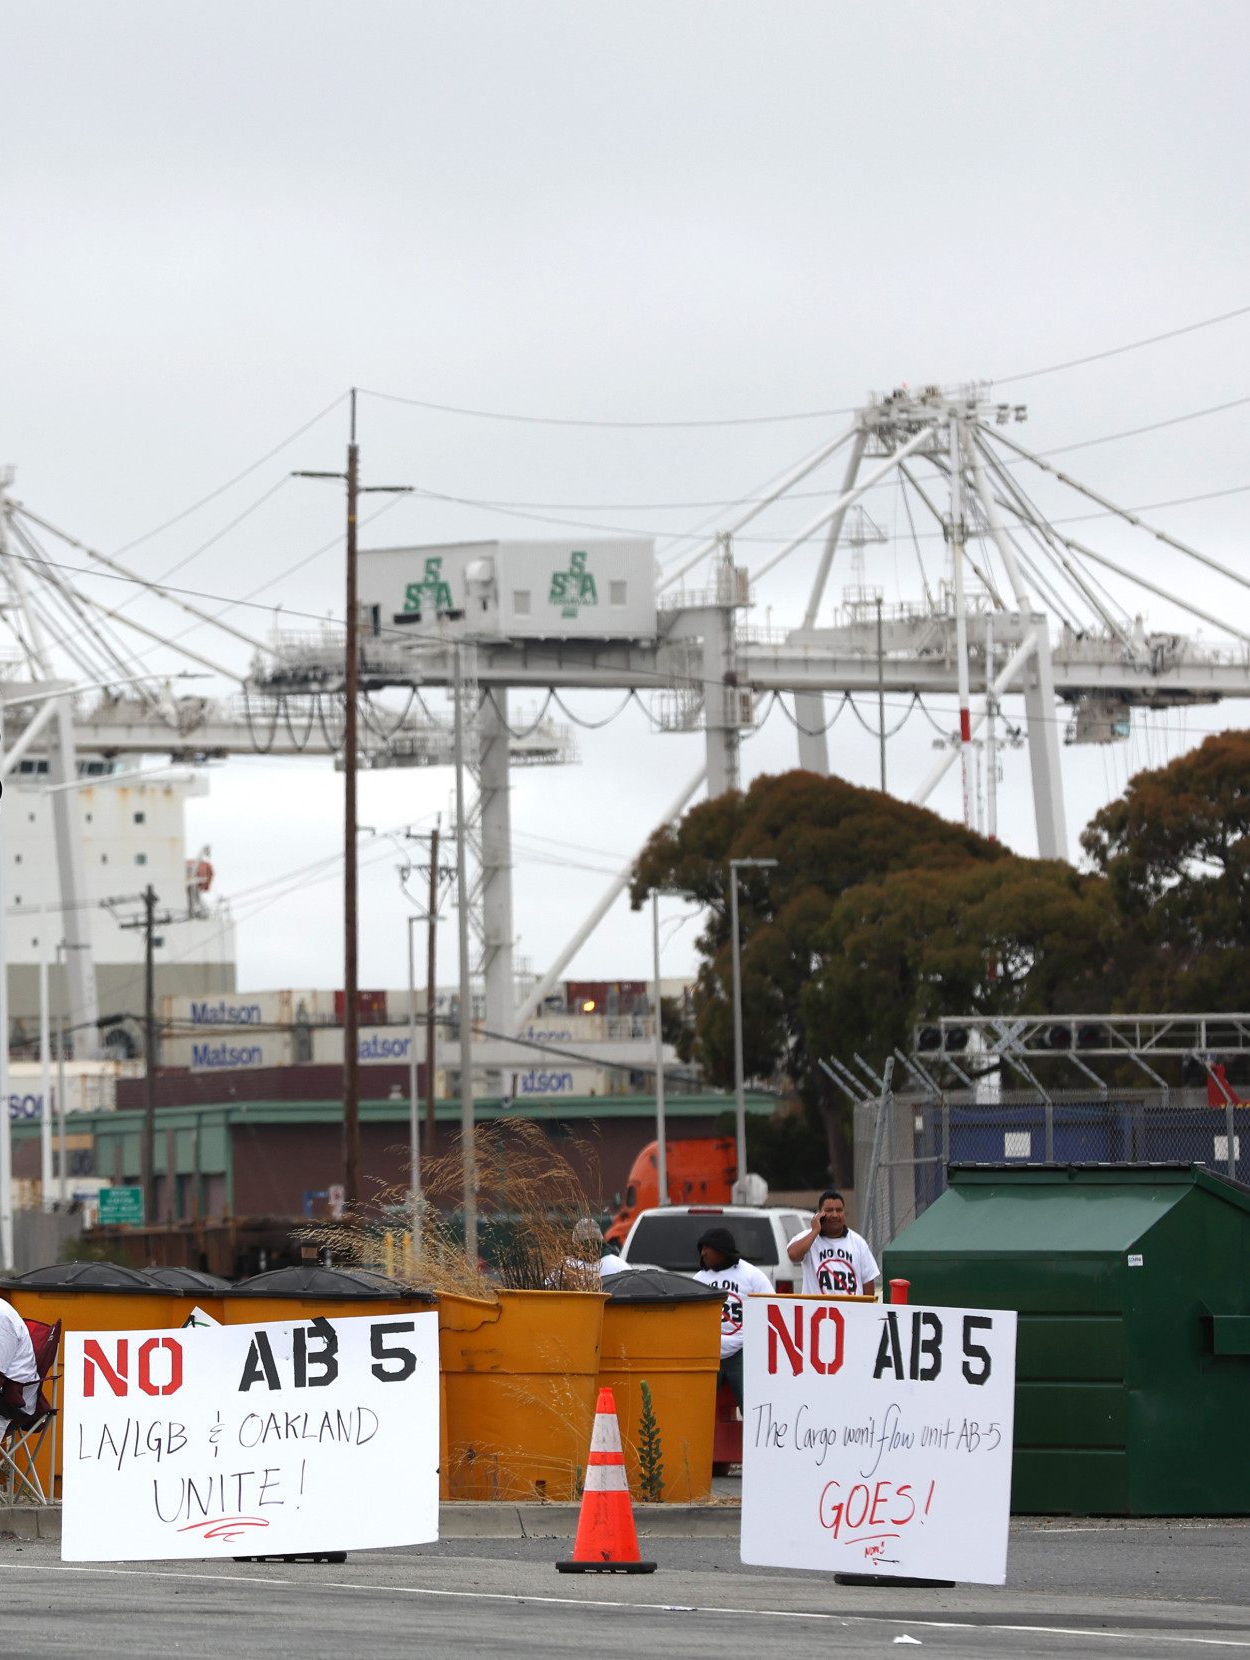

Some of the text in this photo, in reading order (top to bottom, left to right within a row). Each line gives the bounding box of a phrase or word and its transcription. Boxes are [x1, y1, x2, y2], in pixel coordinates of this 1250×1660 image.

[191, 1003, 261, 1023] Matson
[192, 1044, 263, 1066] Matson
[819, 1248, 853, 1263] NO ON
[819, 1271, 856, 1293] AB5
[722, 1280, 738, 1293] ON
[83, 1317, 417, 1397] NO AB 5
[767, 1304, 993, 1386] NO AB 5
[79, 1417, 188, 1471] LA/LGB
[238, 1406, 379, 1448] OAKLAND
[752, 1402, 788, 1448] The
[795, 1404, 837, 1467] Cargo
[860, 1404, 915, 1478] flow
[921, 1418, 954, 1450] unit
[956, 1418, 1001, 1453] AB-5
[154, 1458, 306, 1523] UNITE!
[819, 1480, 935, 1540] GOES!
